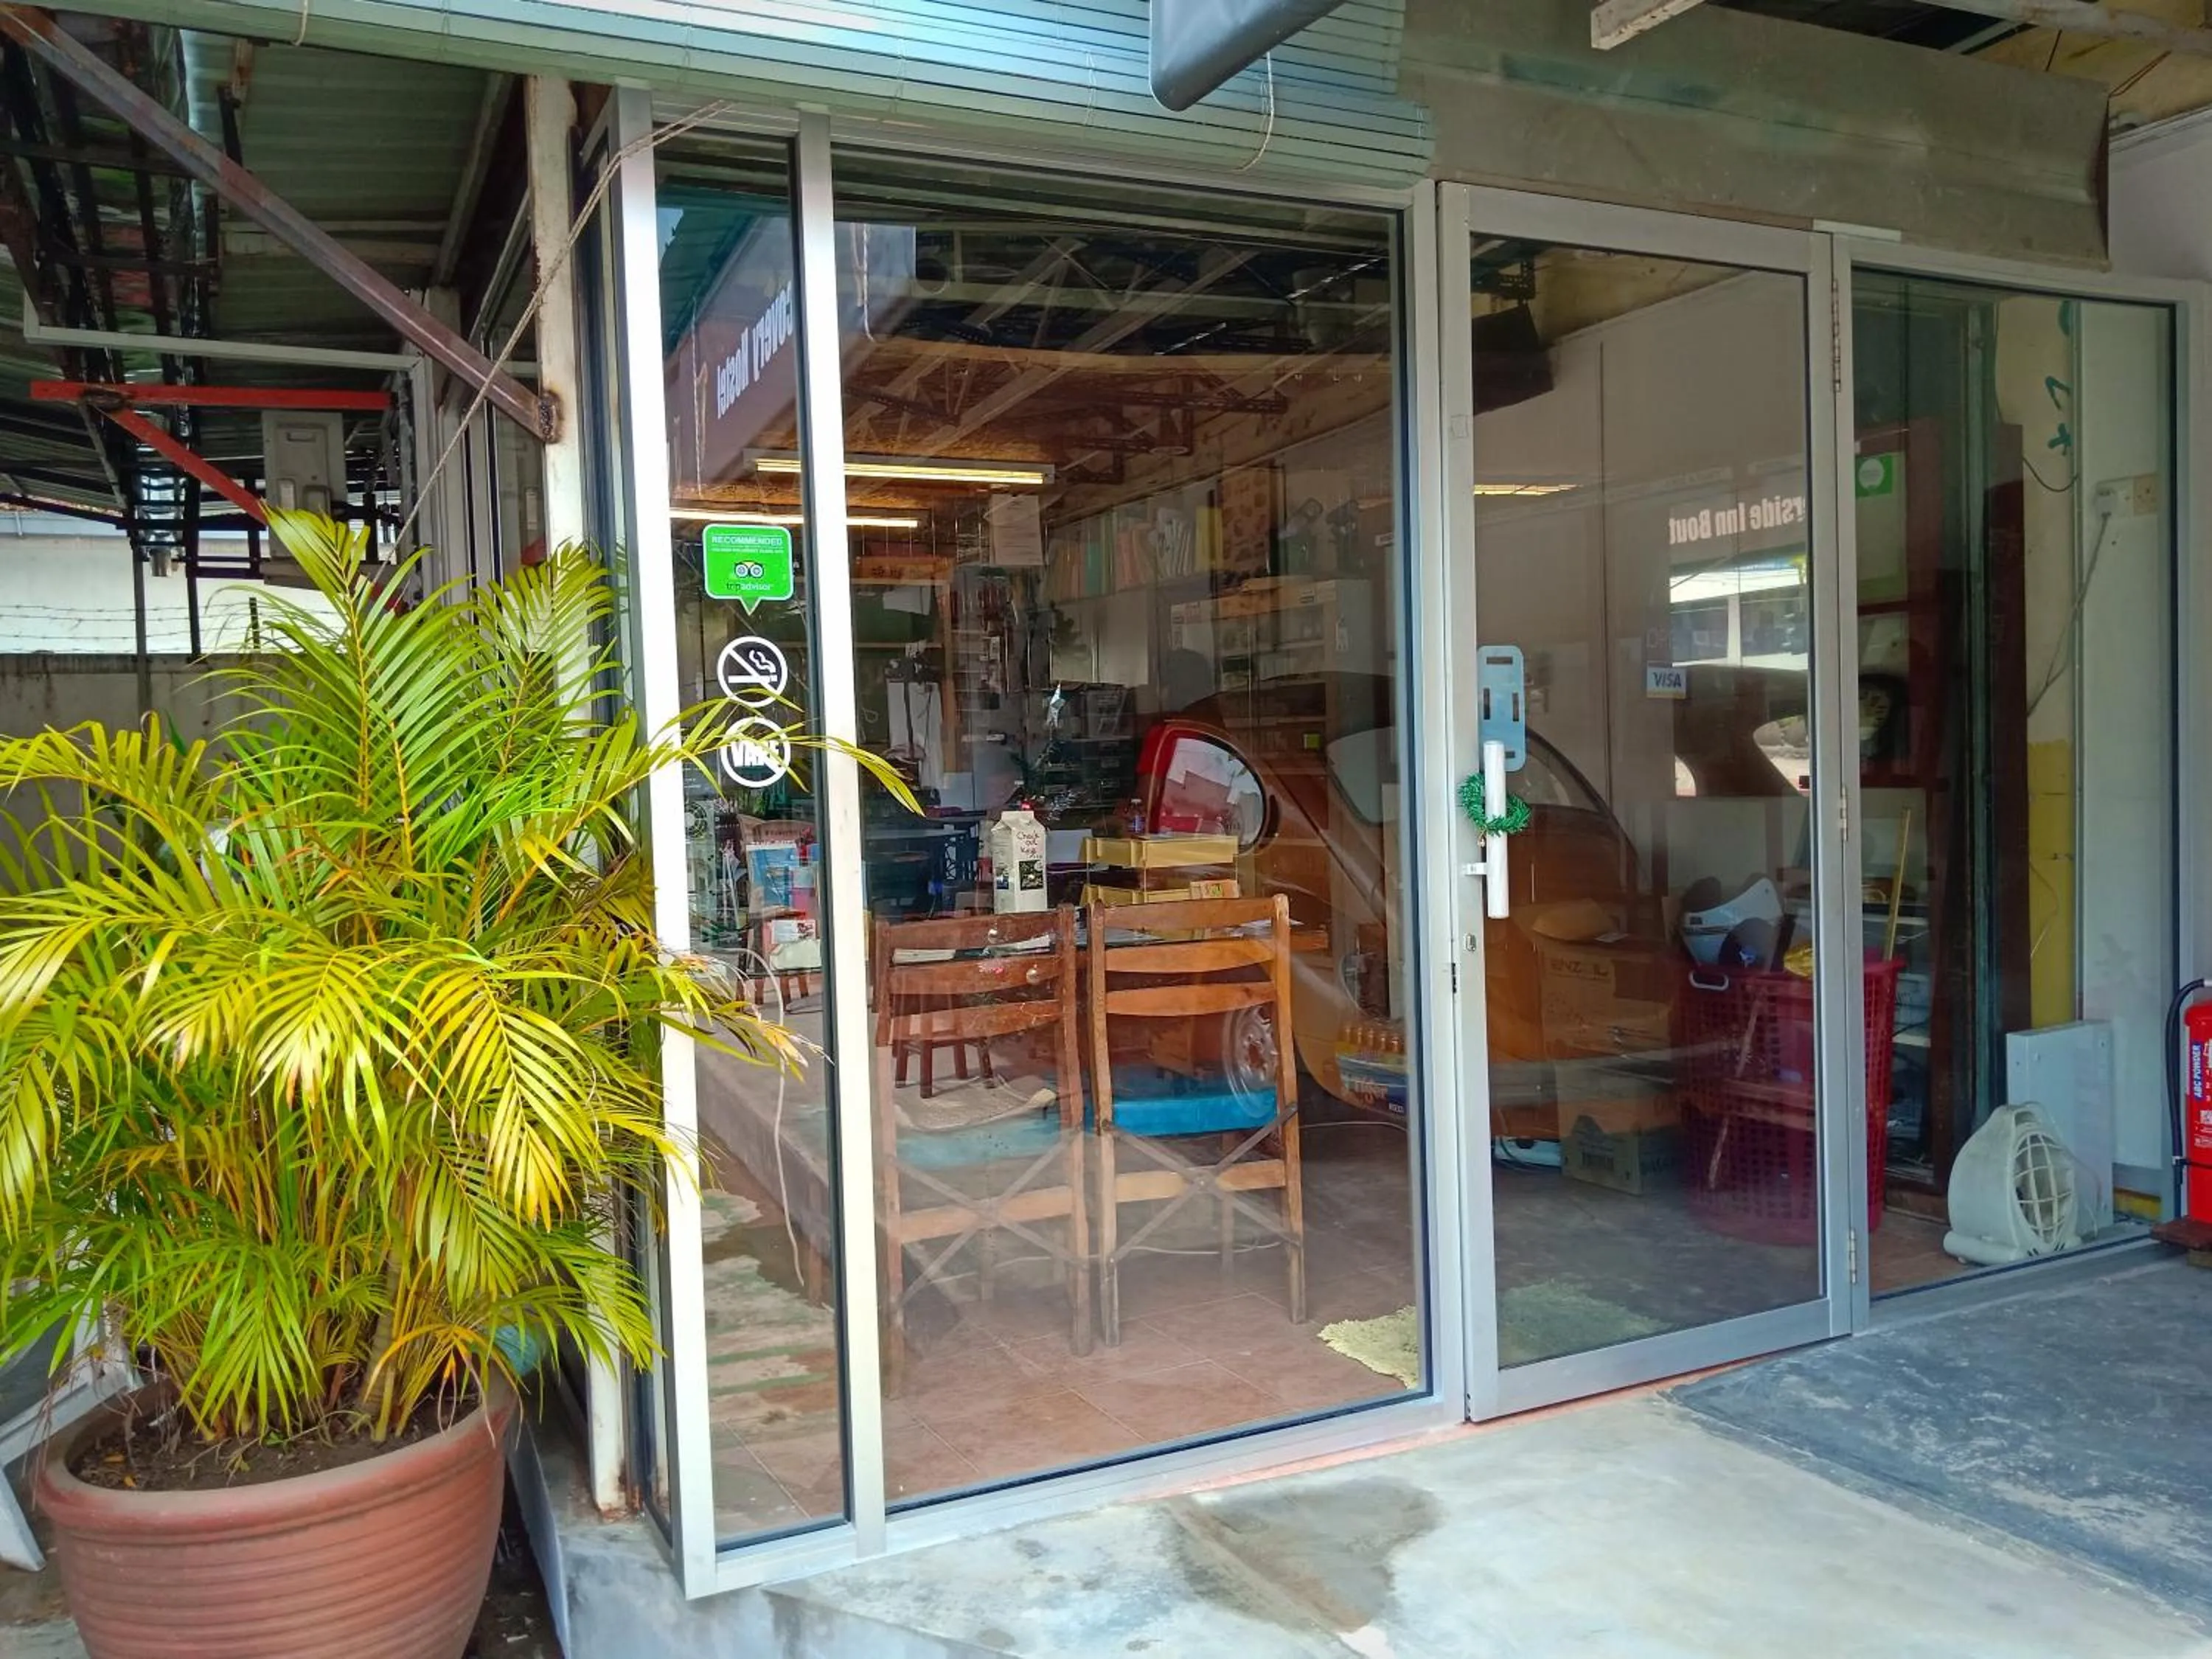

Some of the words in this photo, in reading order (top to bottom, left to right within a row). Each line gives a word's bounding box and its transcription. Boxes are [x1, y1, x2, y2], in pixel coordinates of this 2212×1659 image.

[712, 535, 782, 546] RECOMMENDED
[726, 582, 771, 591] tripadvisor
[1652, 672, 1682, 688] VISA
[2192, 1044, 2202, 1080] POWDER
[2194, 1081, 2202, 1098] ABC
